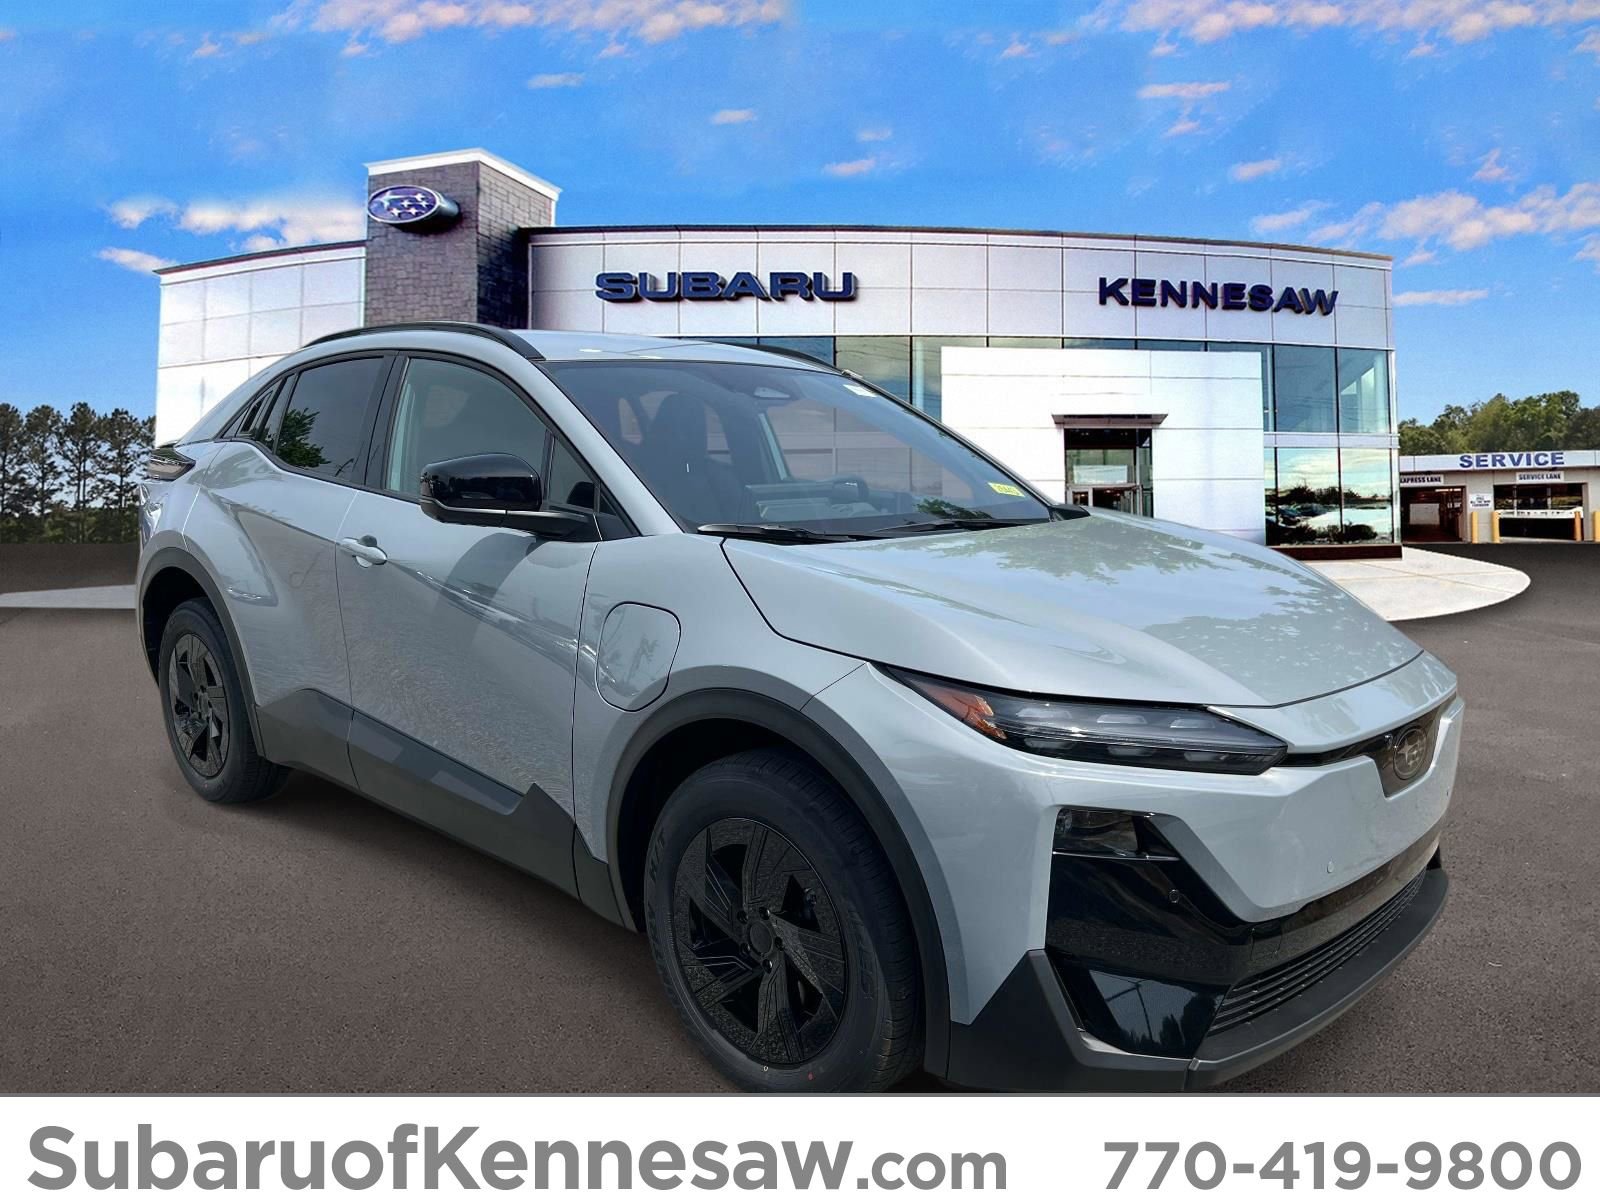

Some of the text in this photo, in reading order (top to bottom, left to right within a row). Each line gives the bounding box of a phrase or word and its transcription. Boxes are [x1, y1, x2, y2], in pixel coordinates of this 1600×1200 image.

[595, 271, 859, 304] SUBARU
[1098, 276, 1339, 315] KENNESAW
[1459, 452, 1565, 469] SERVICE
[1518, 473, 1544, 481] SERVICE
